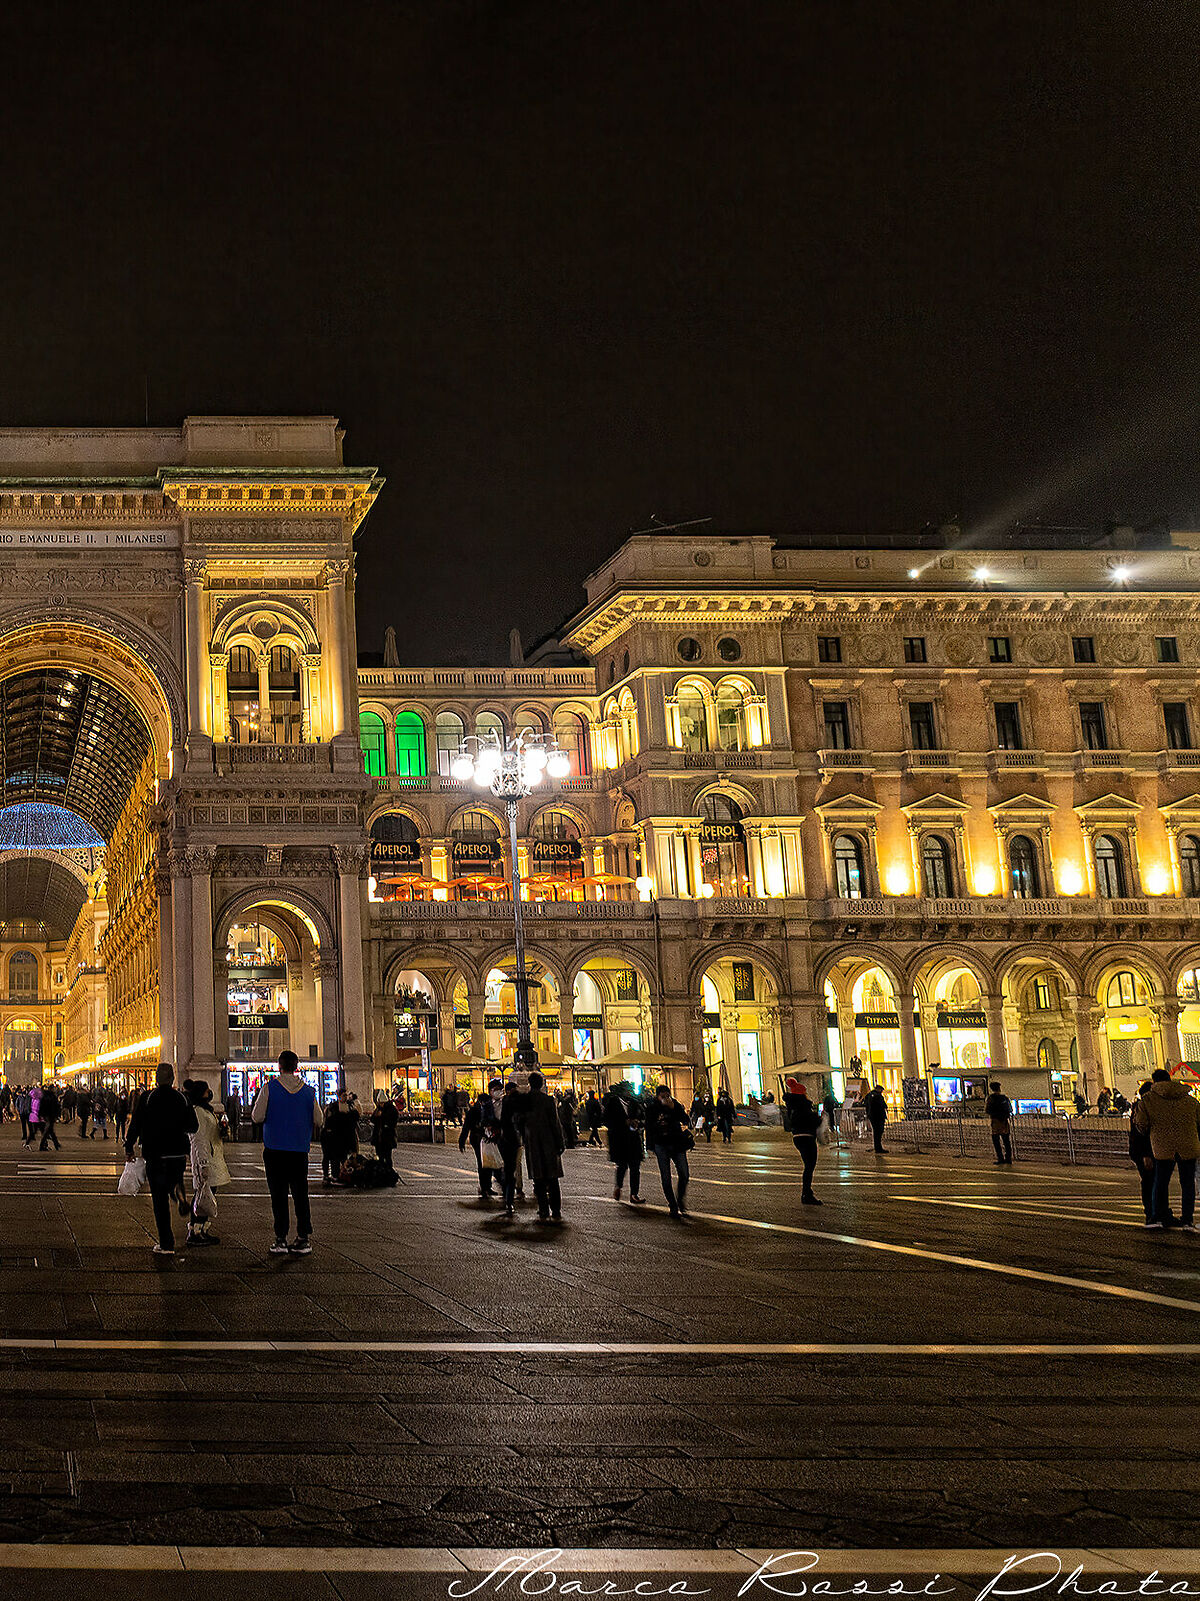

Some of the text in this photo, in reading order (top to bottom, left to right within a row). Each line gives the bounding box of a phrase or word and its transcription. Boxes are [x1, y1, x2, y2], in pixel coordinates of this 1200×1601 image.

[18, 534, 81, 544] EMANUELE
[86, 534, 97, 544] II.
[114, 534, 167, 544] MILANESI
[373, 843, 414, 856] APEROL
[454, 843, 494, 856] APEROL
[534, 843, 575, 856] APEROL
